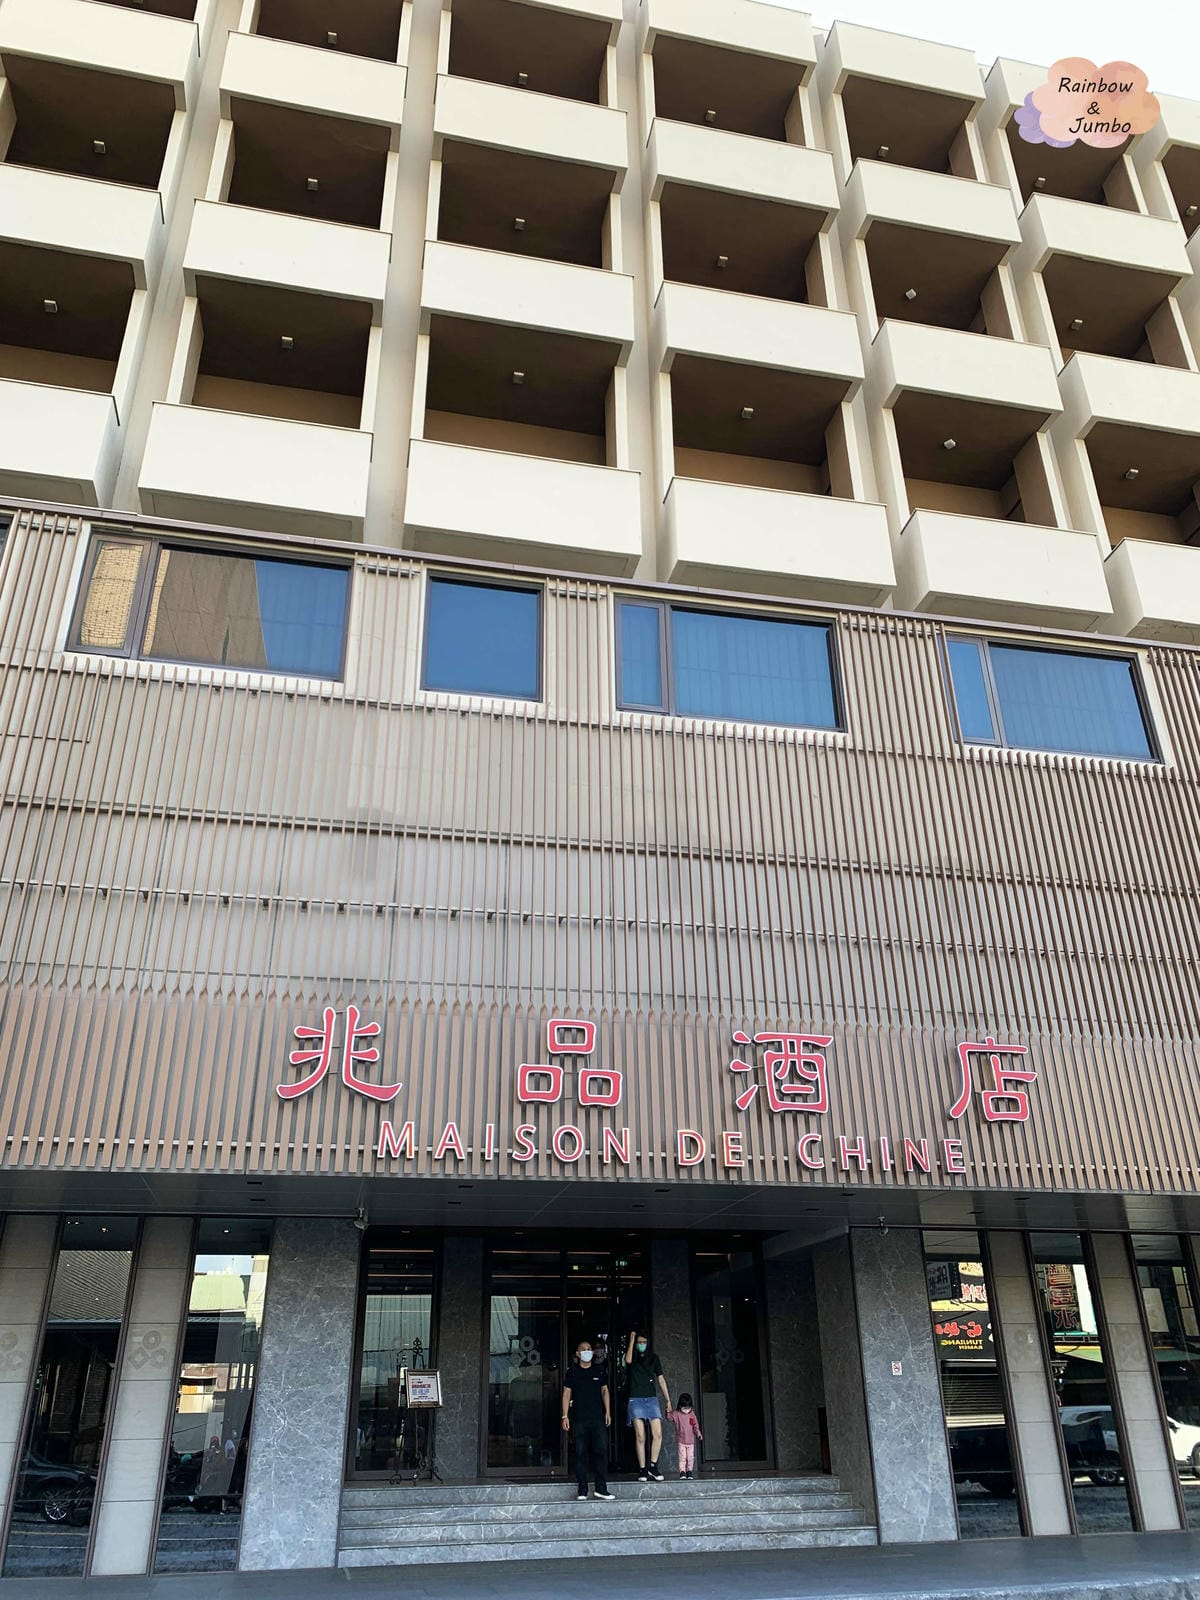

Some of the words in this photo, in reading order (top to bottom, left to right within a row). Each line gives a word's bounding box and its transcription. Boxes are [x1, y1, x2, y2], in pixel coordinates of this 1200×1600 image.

[276, 1005, 1038, 1122] 兆品酒店
[377, 1120, 631, 1164] MAISON
[677, 1129, 746, 1168] DE
[797, 1132, 968, 1174] CHINE
